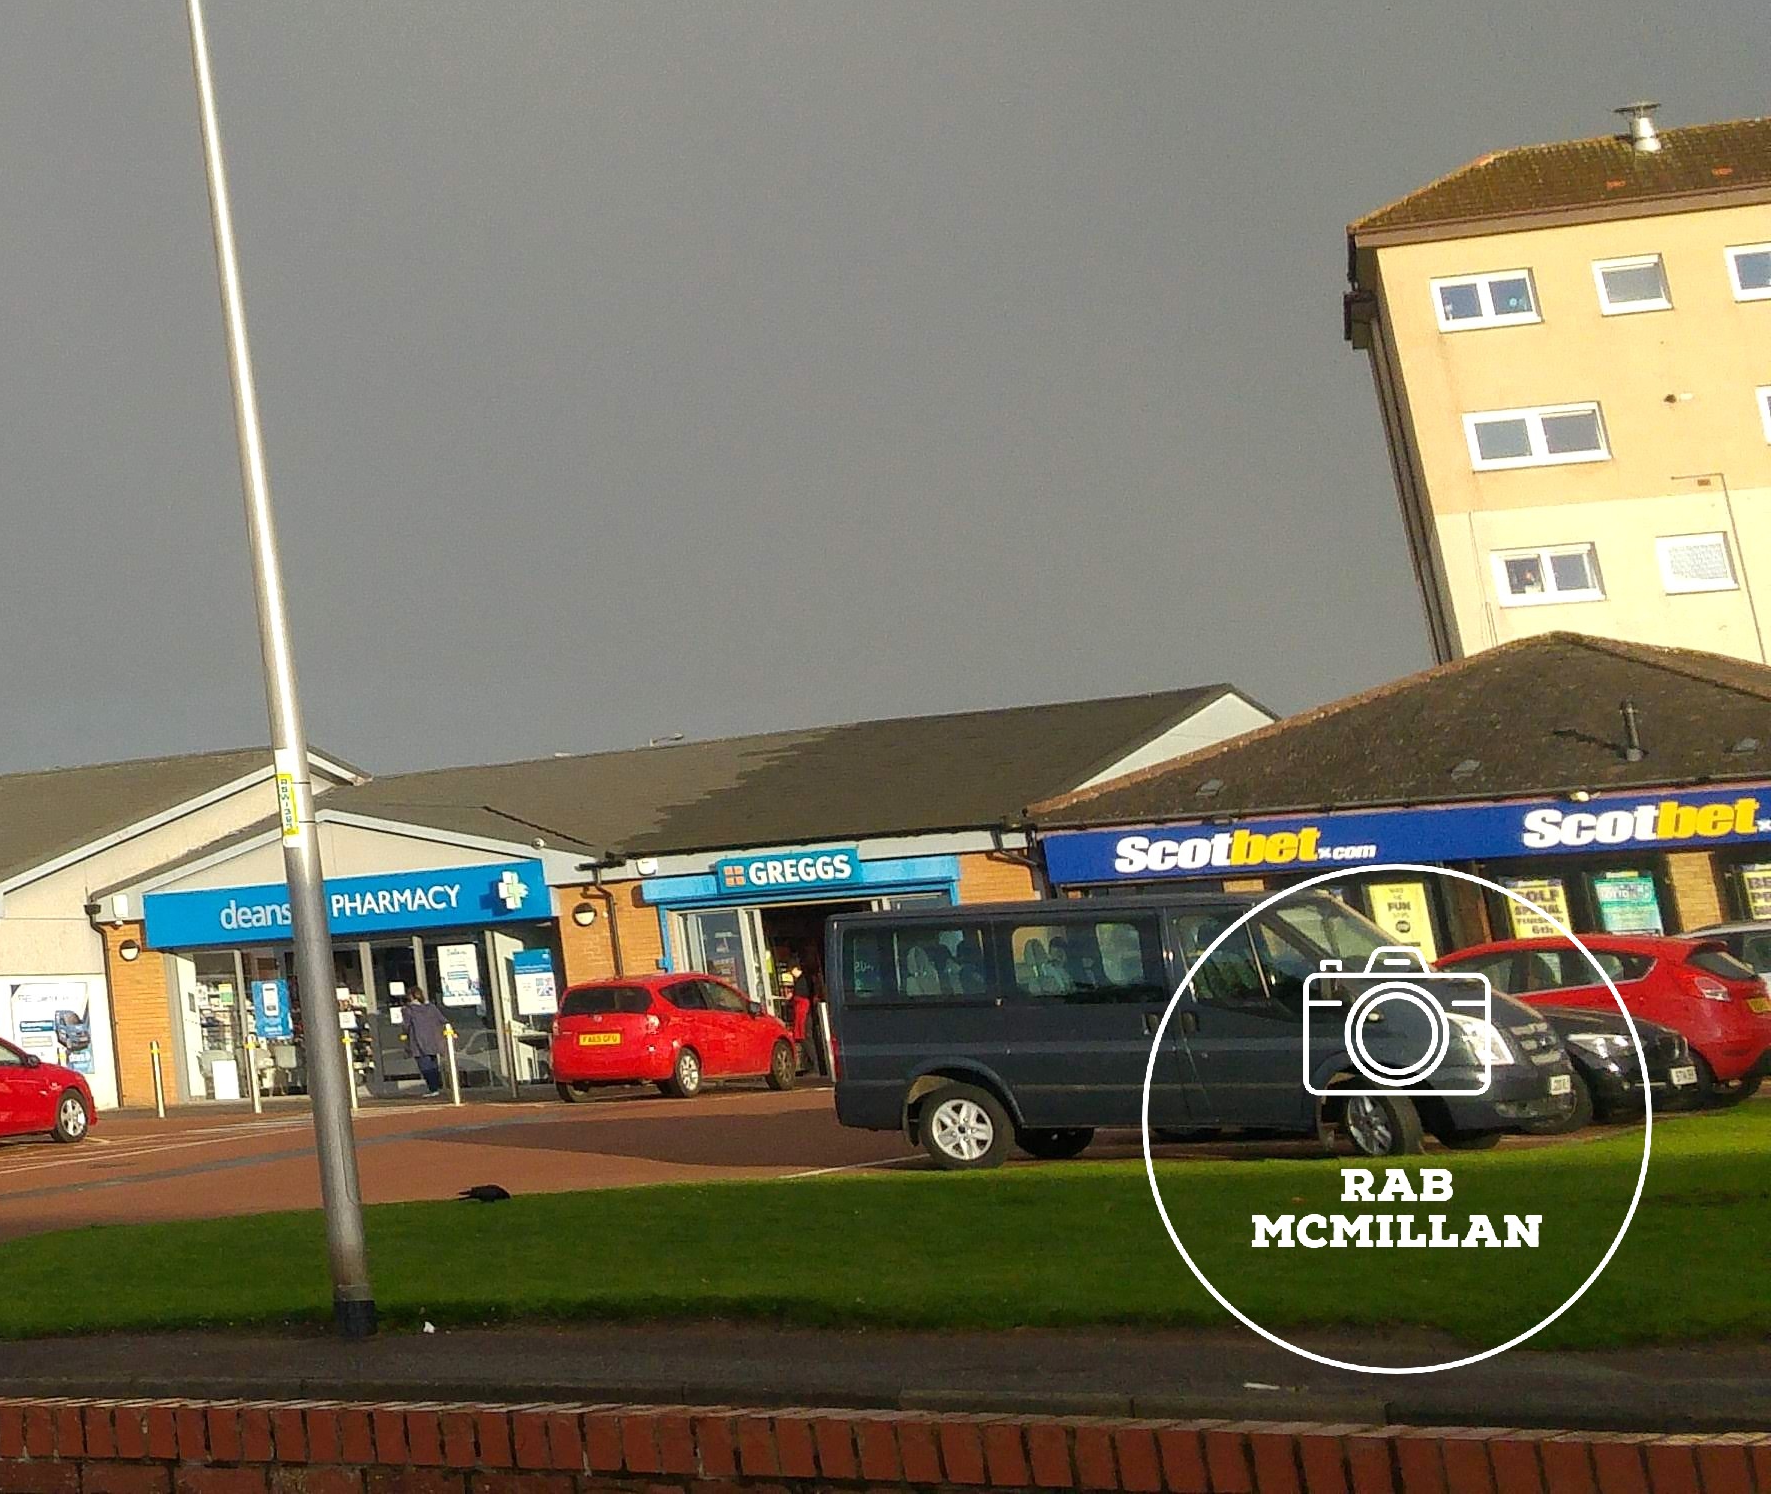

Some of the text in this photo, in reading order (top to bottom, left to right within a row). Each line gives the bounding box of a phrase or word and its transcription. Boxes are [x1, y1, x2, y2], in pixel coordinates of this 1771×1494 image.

[1523, 797, 1759, 848] Scotbet
[749, 854, 852, 885] GREGGS
[220, 884, 460, 930] deans PHARMACY
